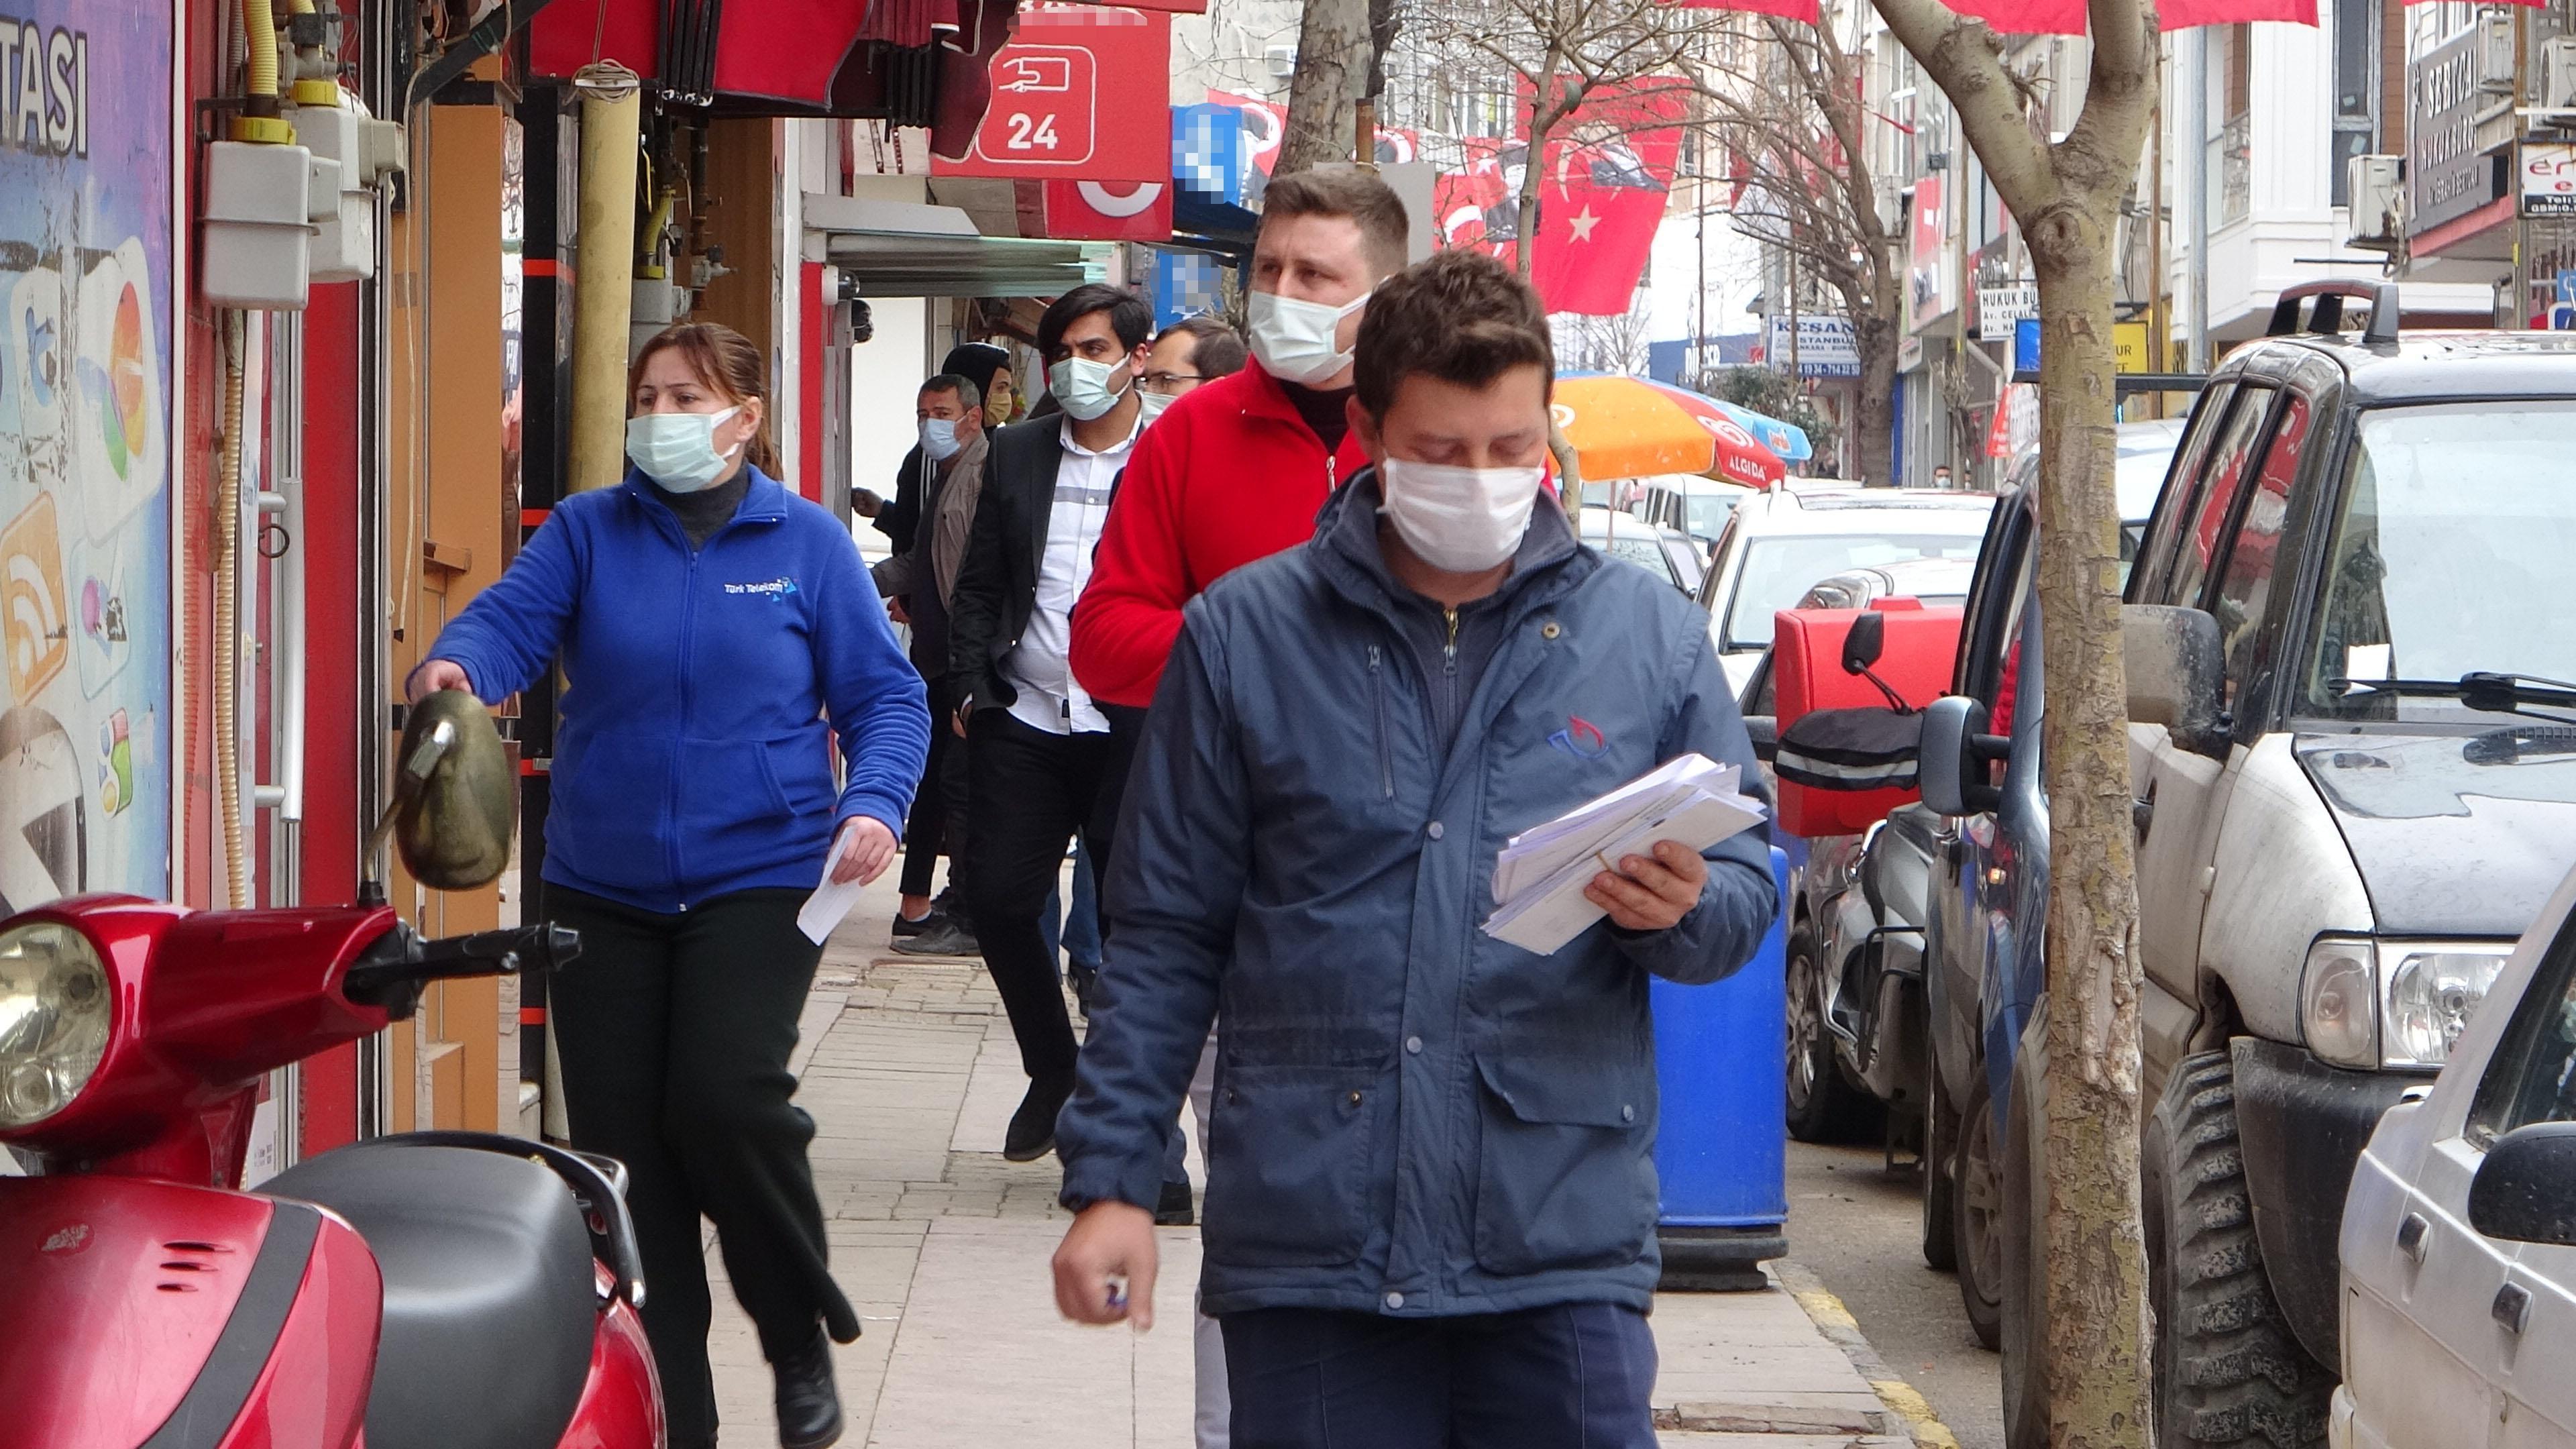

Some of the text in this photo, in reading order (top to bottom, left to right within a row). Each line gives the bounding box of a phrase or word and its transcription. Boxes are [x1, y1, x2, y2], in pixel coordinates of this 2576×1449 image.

[1008, 112, 1058, 150] 24
[1983, 292, 2017, 307] HUKUK
[1984, 311, 1996, 319] Av.
[1984, 322, 2015, 333] Av. HA
[1729, 454, 1766, 482] ALGIDA
[724, 582, 783, 594] Türk Telekom
